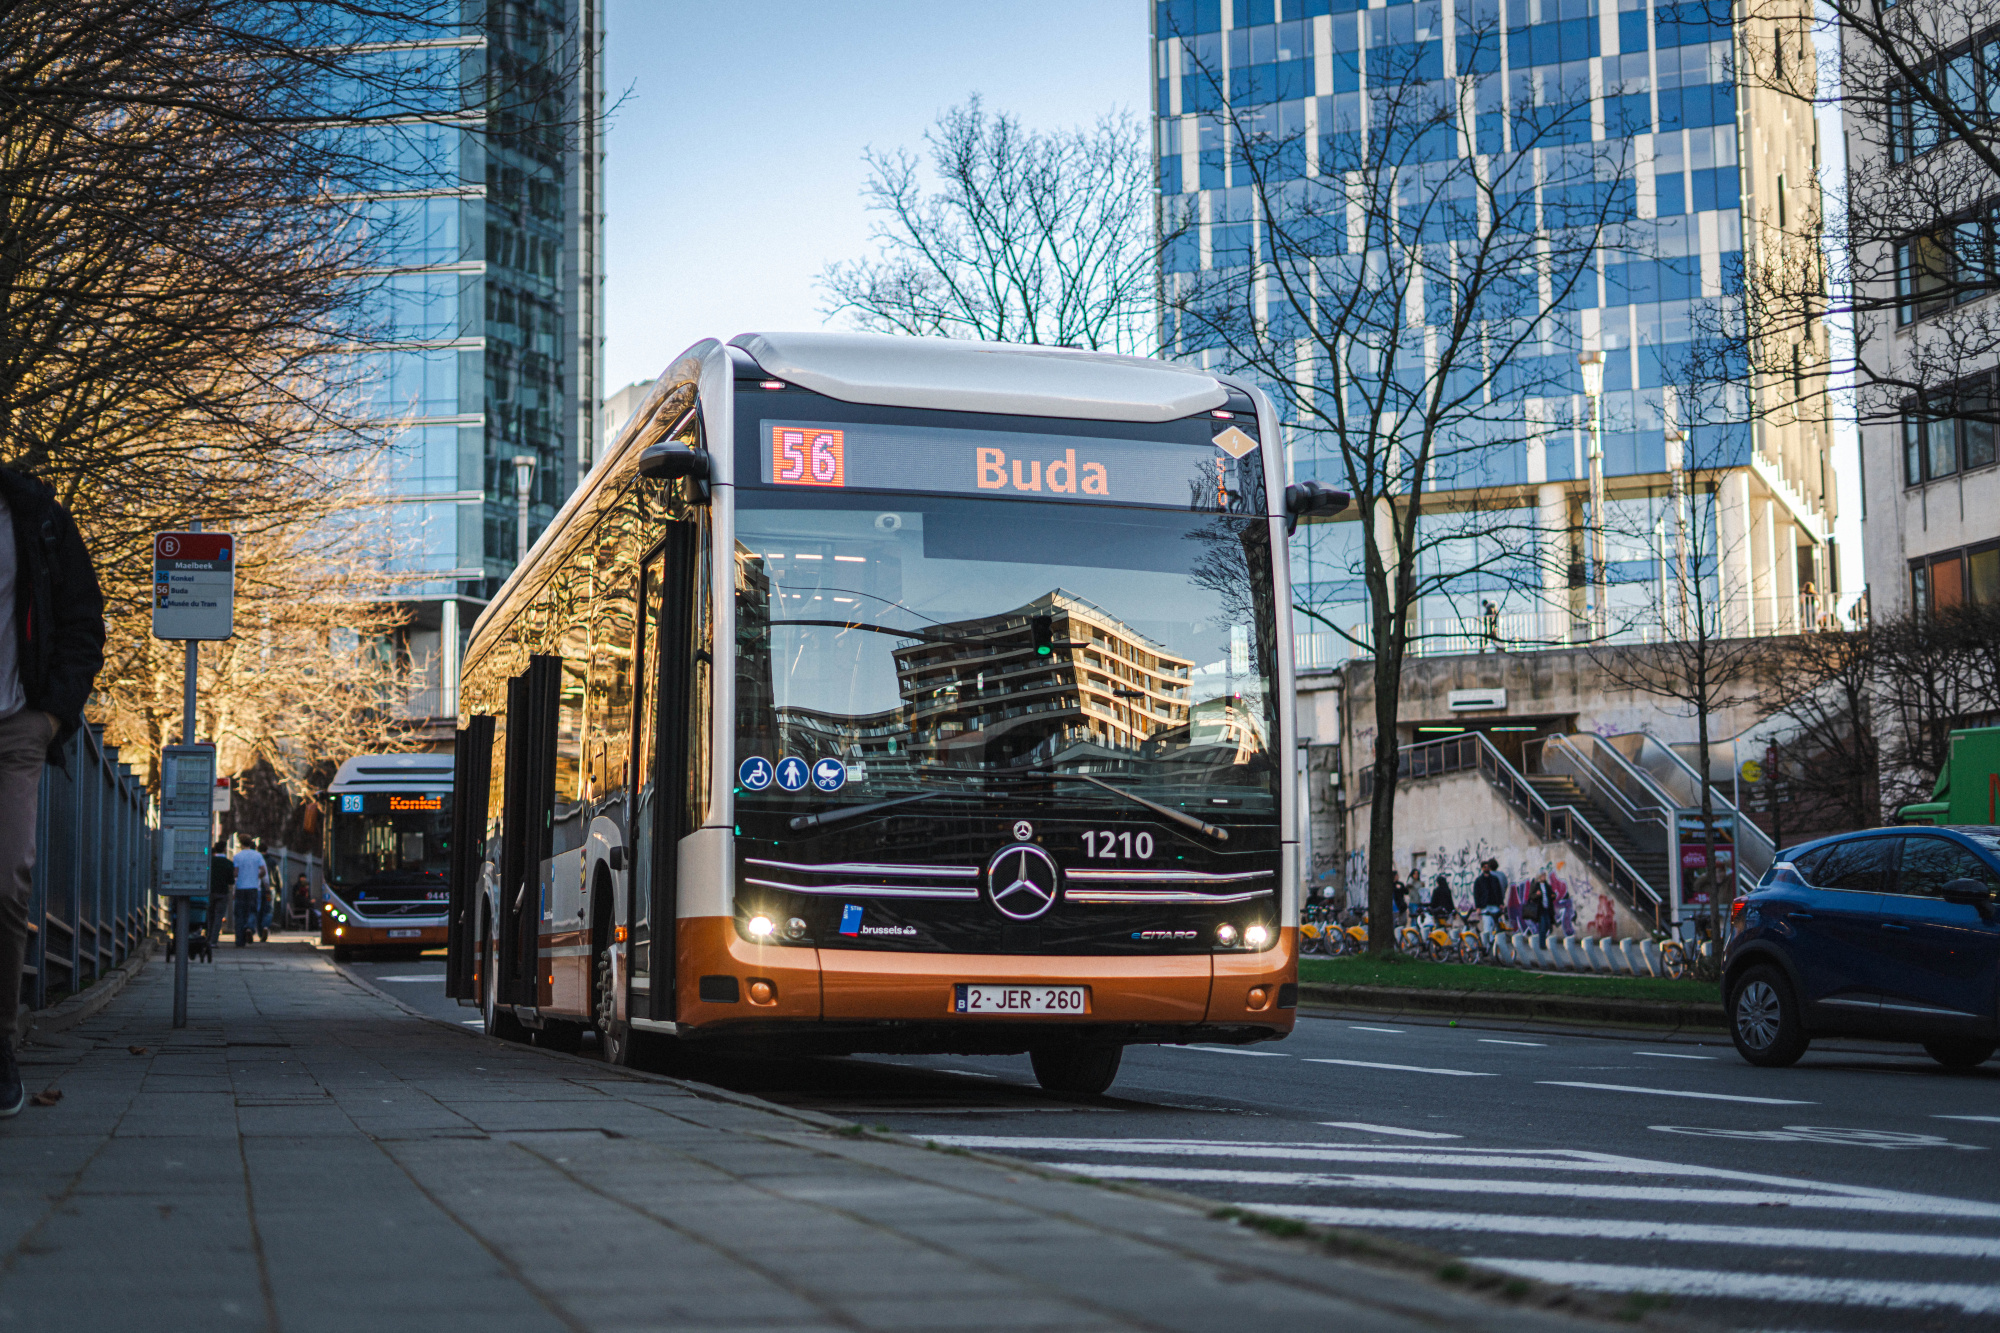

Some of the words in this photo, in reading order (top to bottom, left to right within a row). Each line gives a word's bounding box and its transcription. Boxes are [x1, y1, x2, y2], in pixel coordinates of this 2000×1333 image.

[781, 432, 836, 481] 56
[976, 447, 1110, 495] Buda
[165, 540, 174, 552] B
[157, 572, 169, 581] 36
[156, 585, 168, 594] 56
[344, 795, 361, 811] 36
[389, 795, 441, 810] Konkel
[1081, 830, 1153, 859] 1210
[860, 925, 902, 935] .brussels
[1131, 931, 1198, 940] eCITARO
[958, 999, 966, 1009] B
